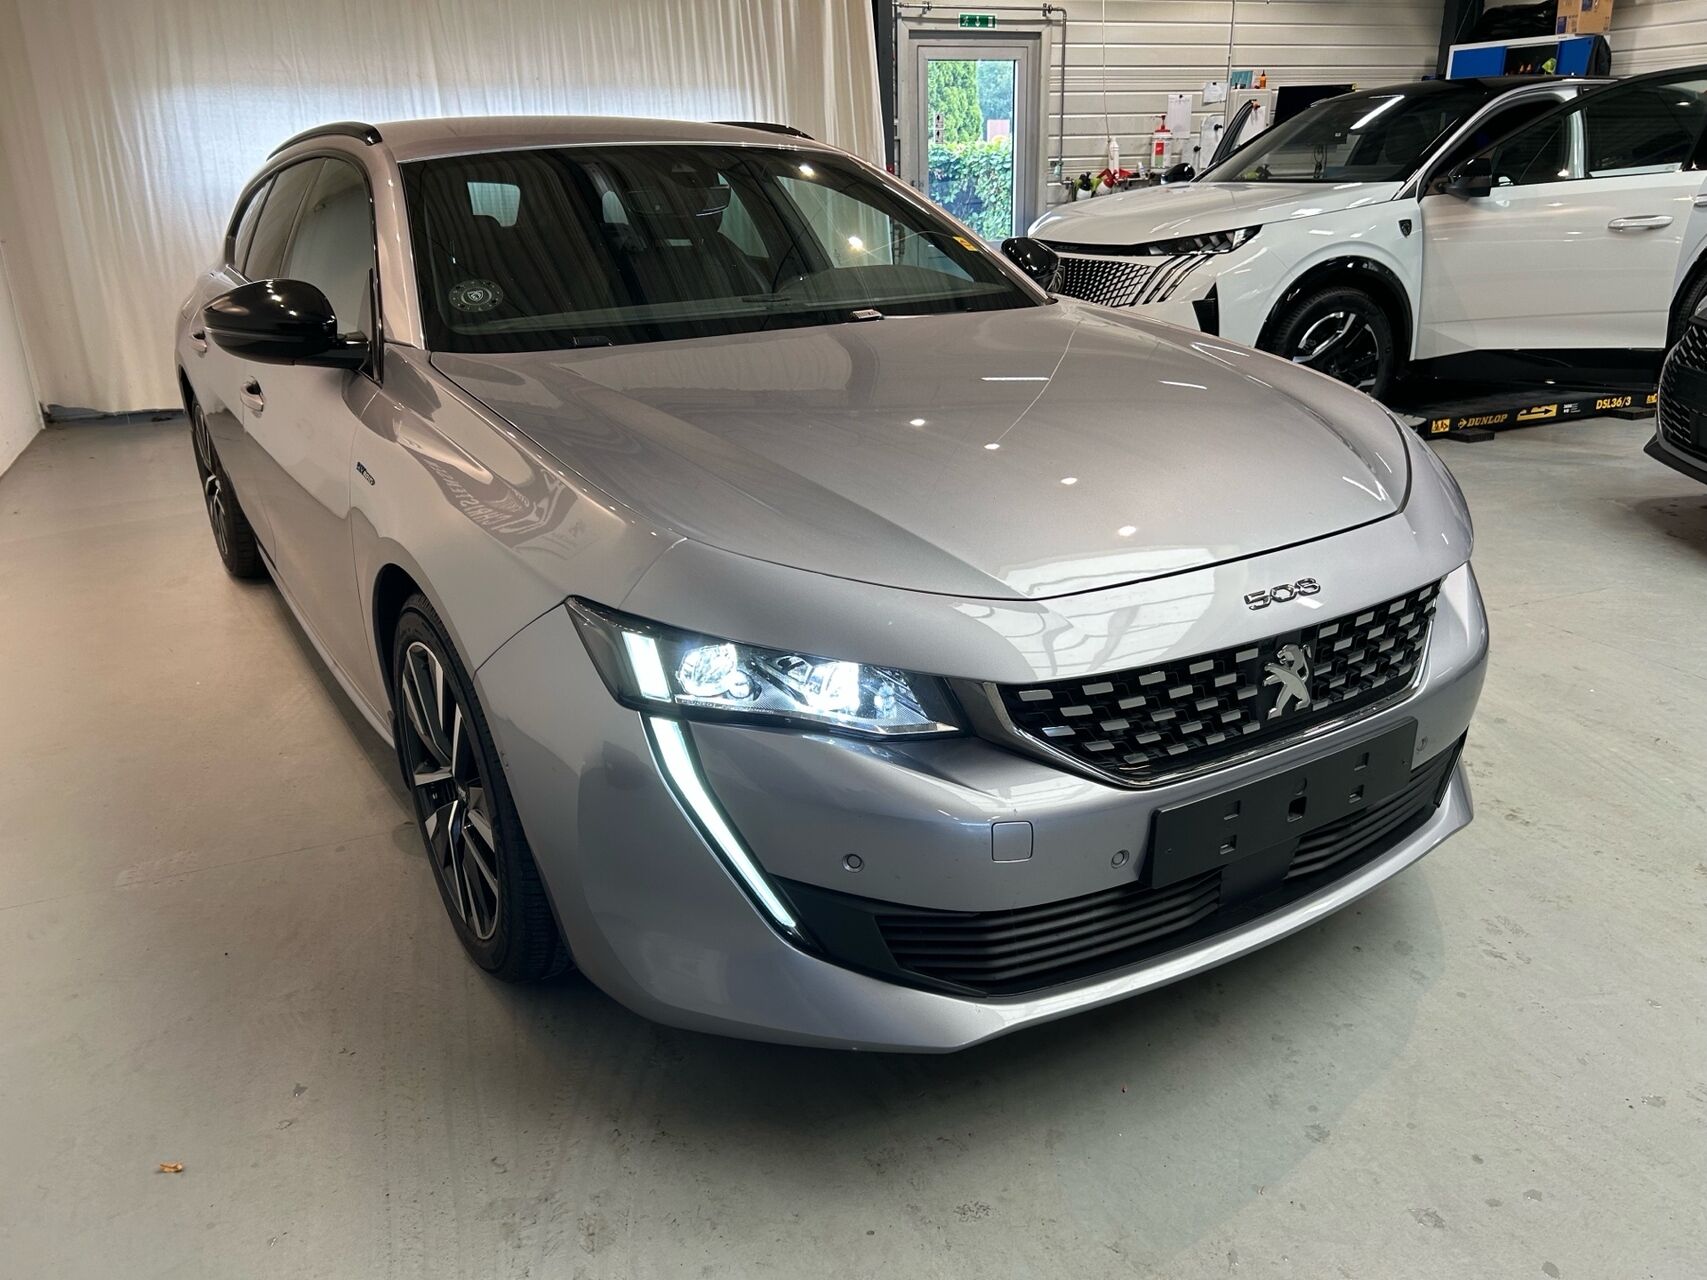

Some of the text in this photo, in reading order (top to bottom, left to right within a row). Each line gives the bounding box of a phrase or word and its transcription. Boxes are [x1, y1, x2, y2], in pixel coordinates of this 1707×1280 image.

[1595, 395, 1632, 410] DSL36/3
[1467, 413, 1509, 428] DUNLOP
[1243, 577, 1321, 611] 508
